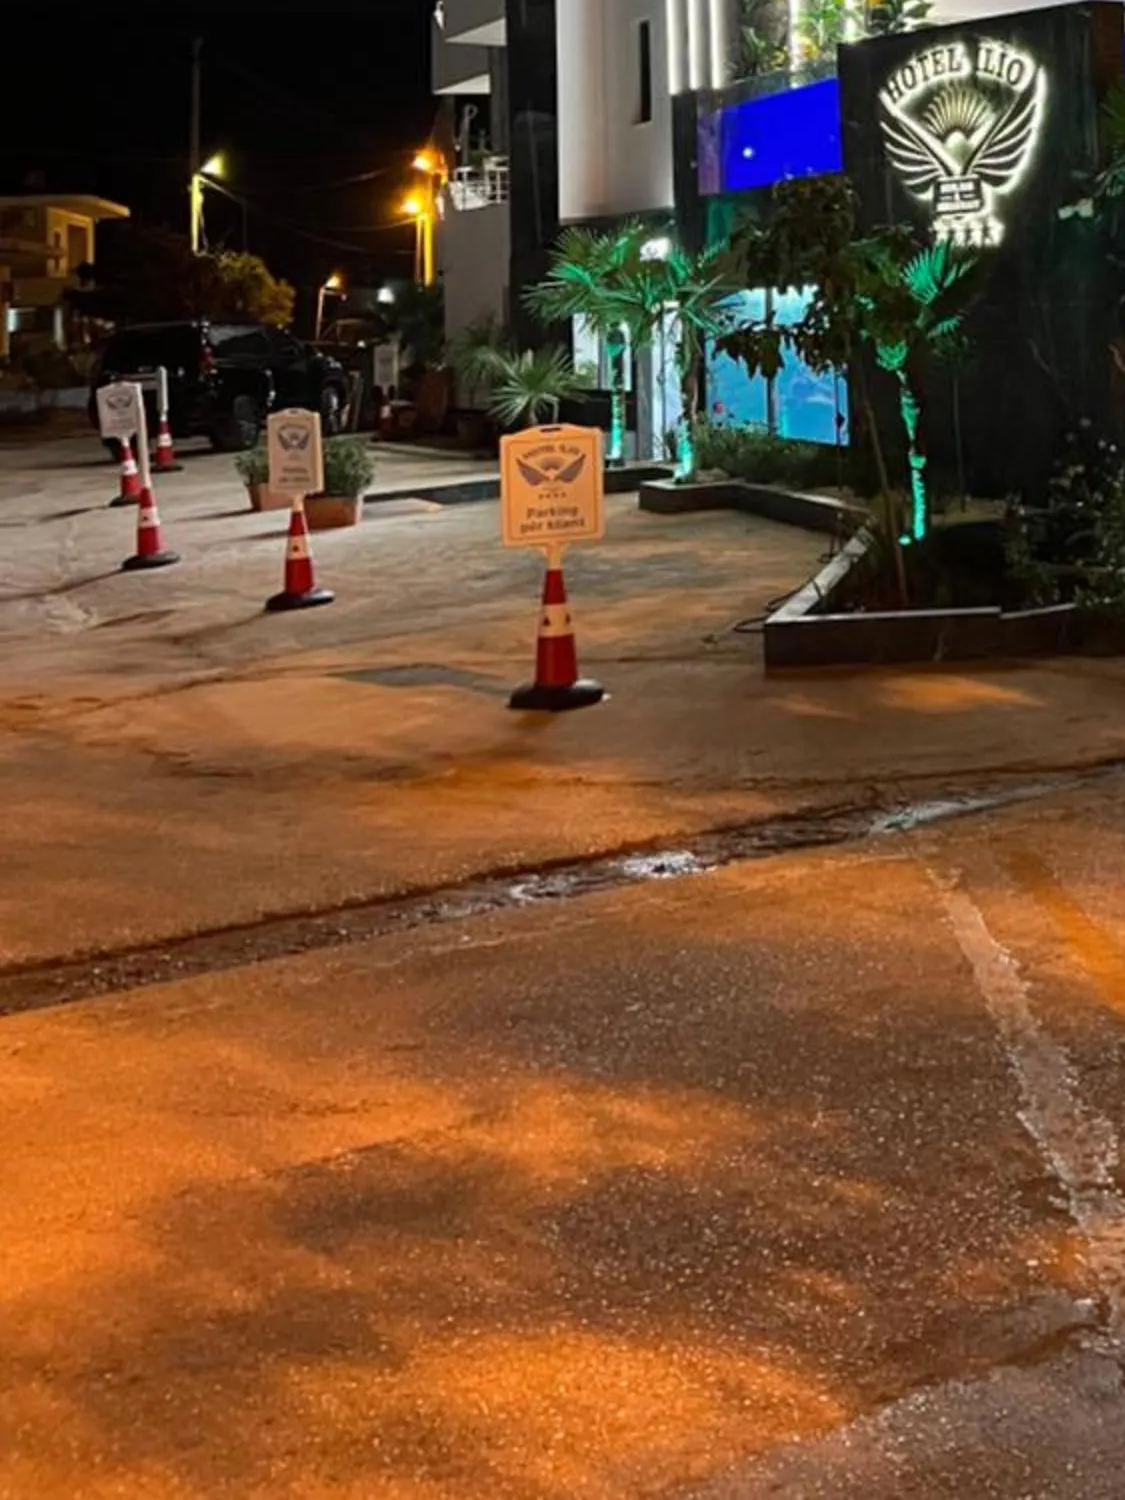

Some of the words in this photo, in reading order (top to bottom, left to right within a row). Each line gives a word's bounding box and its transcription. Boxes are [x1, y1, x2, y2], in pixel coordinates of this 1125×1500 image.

[885, 46, 963, 103] HOTEL
[974, 46, 1025, 86] ILIO
[526, 506, 579, 519] Parking
